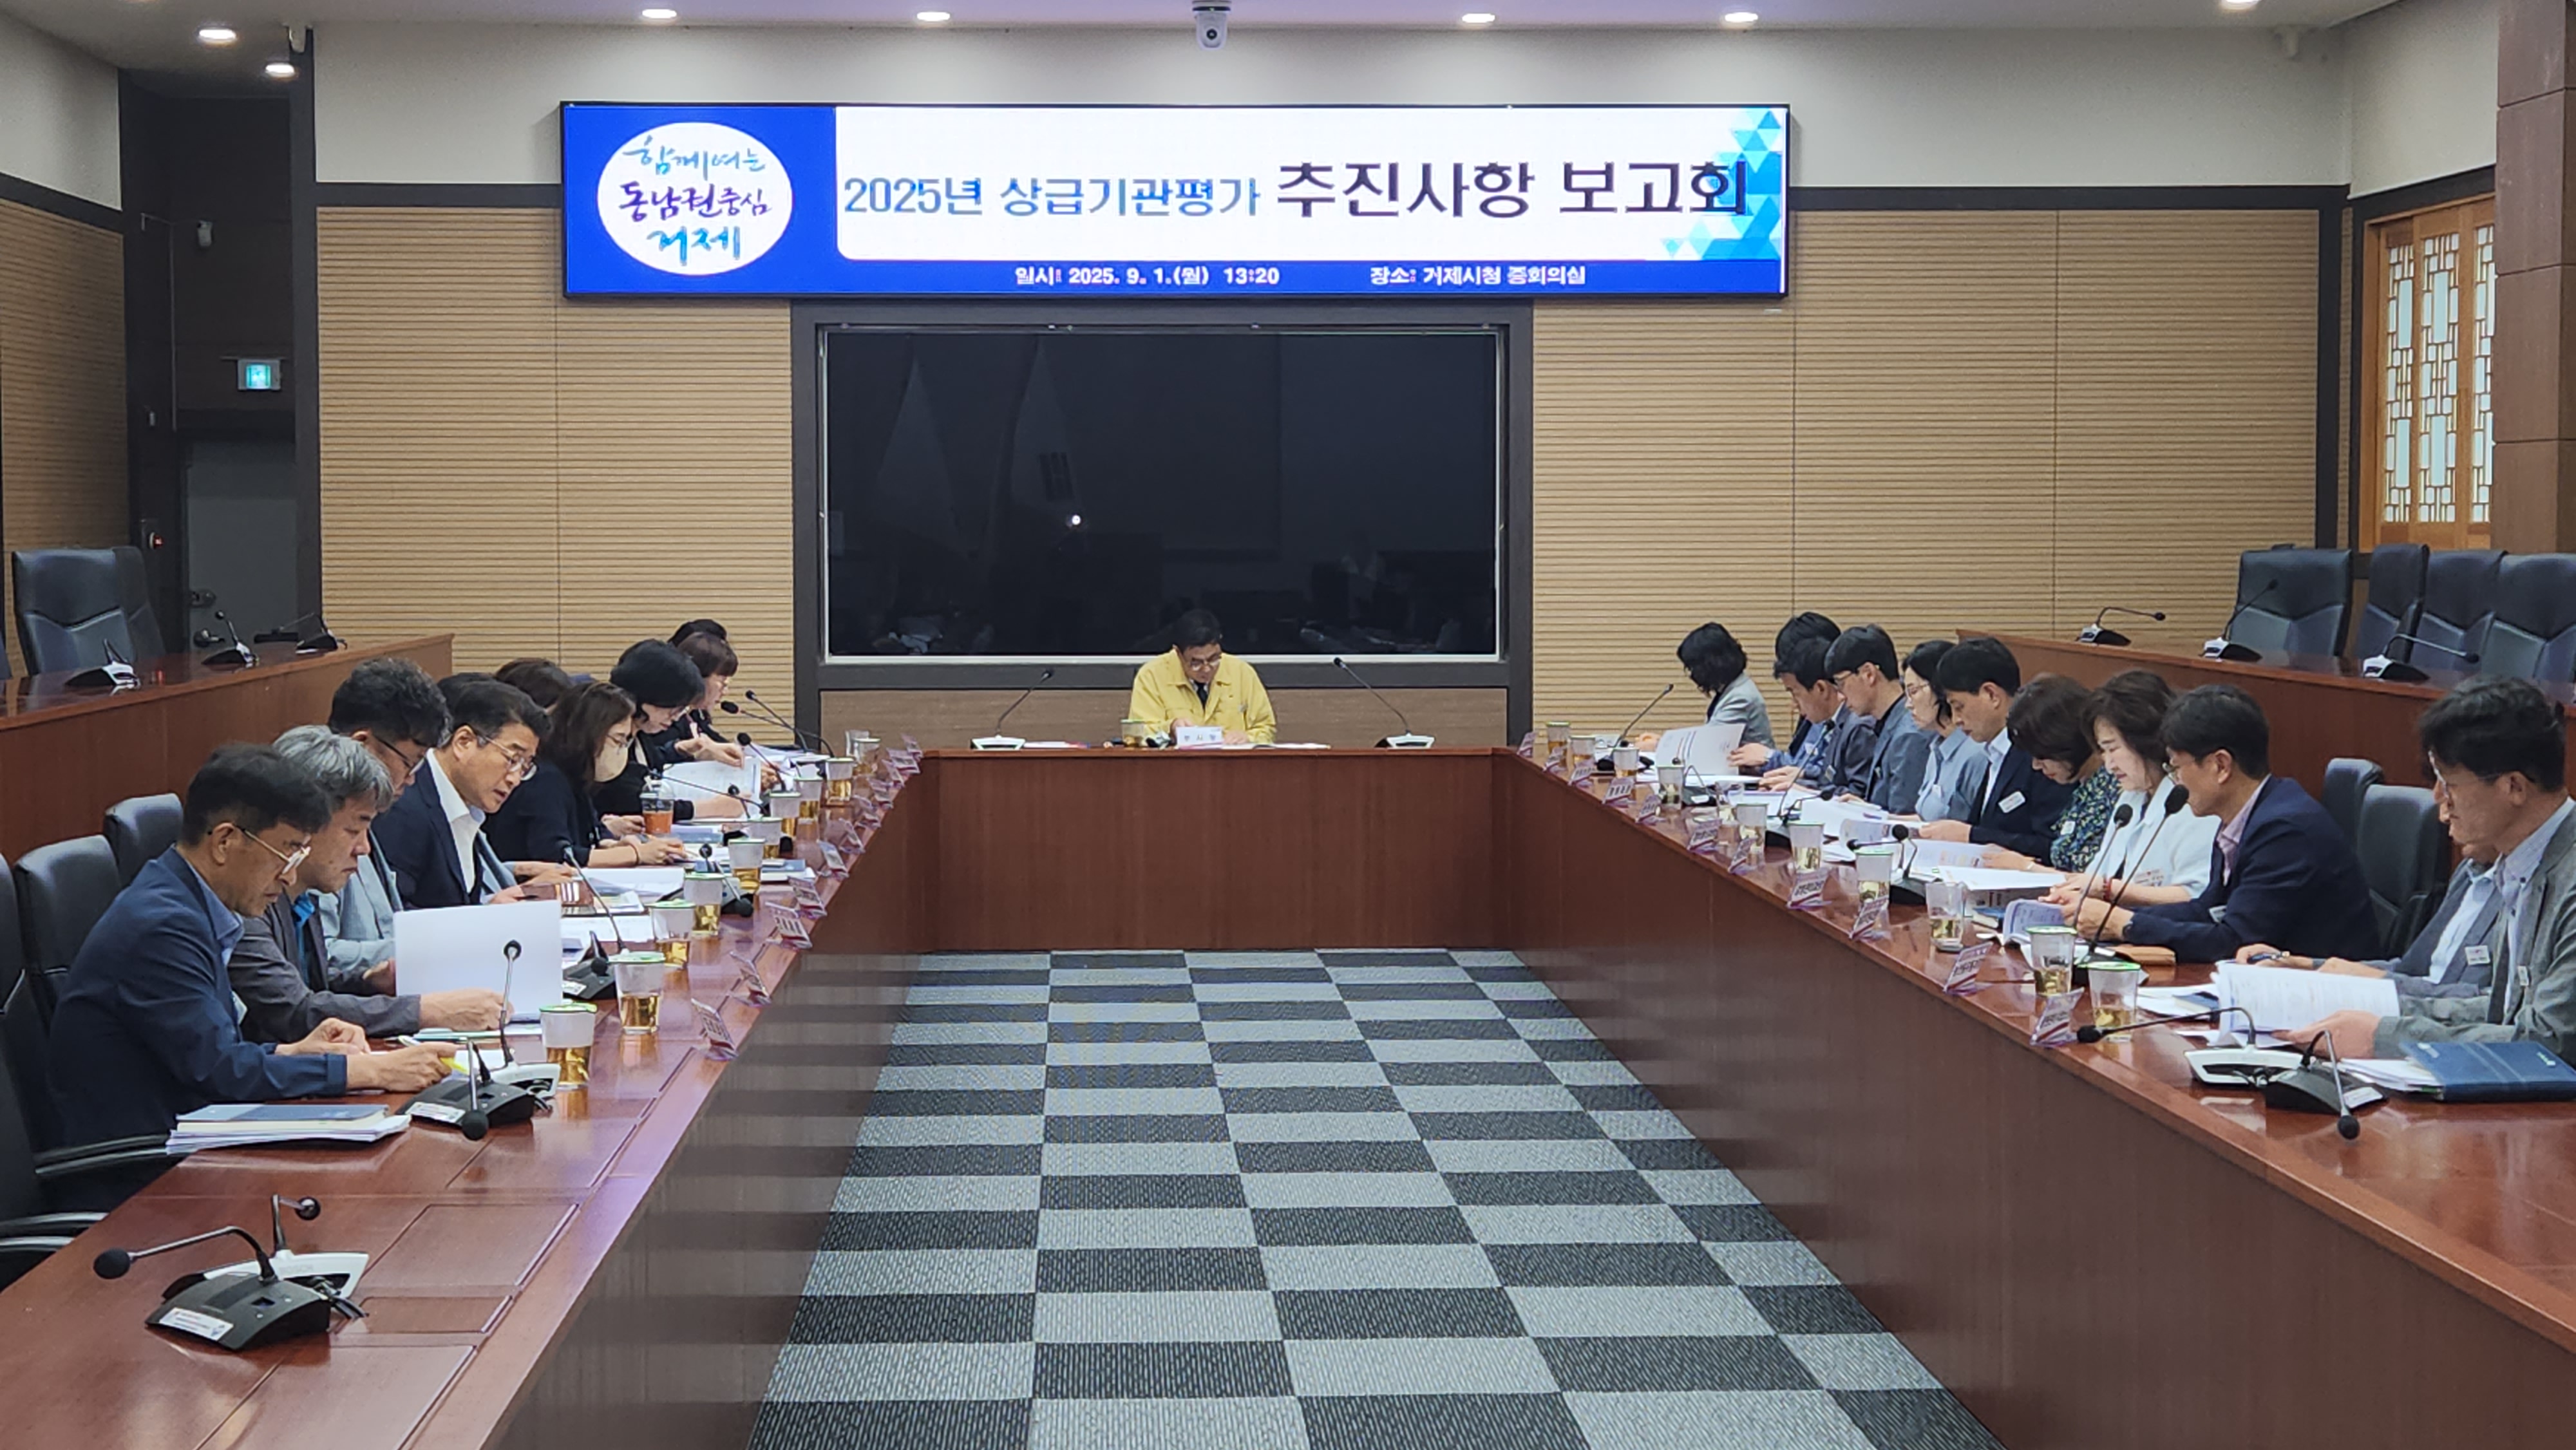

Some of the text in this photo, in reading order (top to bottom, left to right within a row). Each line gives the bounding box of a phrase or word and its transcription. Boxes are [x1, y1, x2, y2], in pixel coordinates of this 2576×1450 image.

[844, 161, 1748, 218] 2025년 상급기관평가 추진사항 보고회
[646, 225, 741, 267] 거제
[1014, 266, 1063, 286] 일시:
[1068, 267, 1121, 285] 2025.
[1126, 267, 1147, 285] 9.
[1223, 266, 1280, 285] 13:20
[1370, 265, 1586, 286] 장소: 거제시청 중회의실
